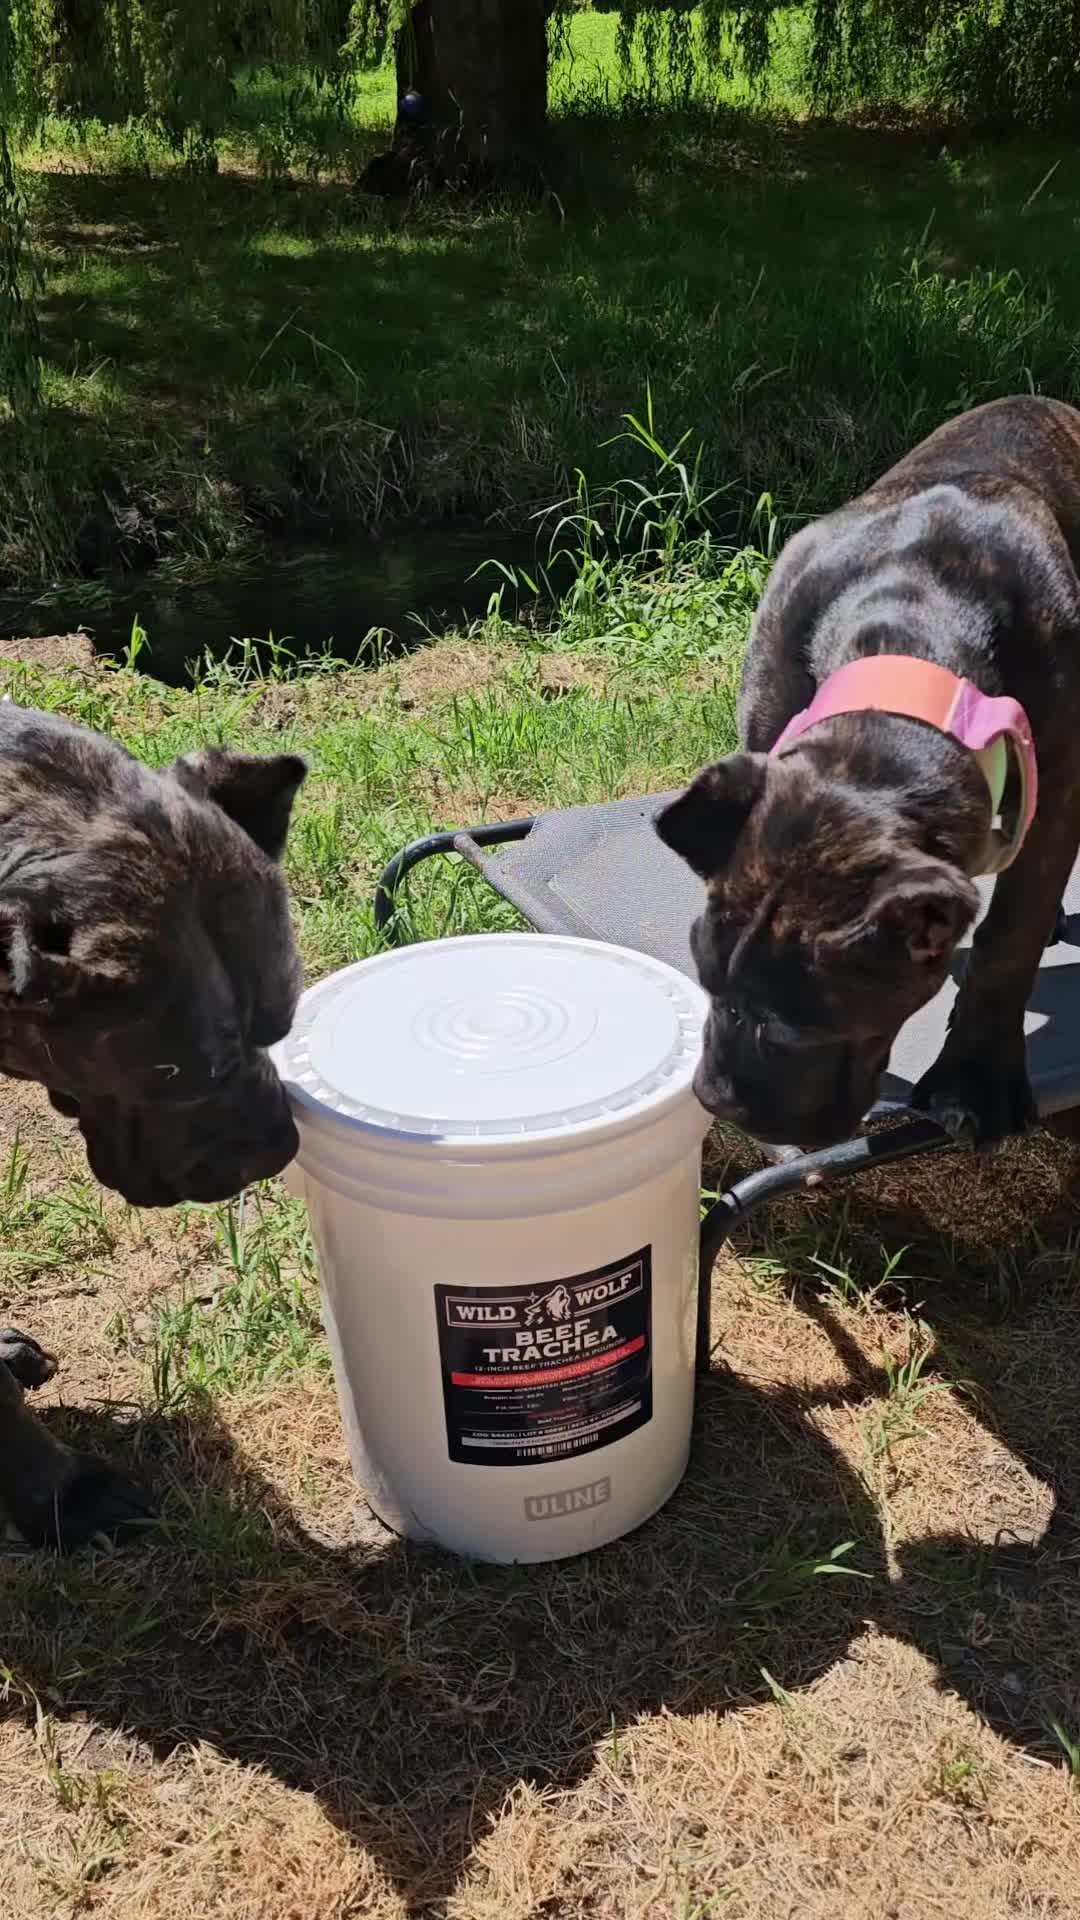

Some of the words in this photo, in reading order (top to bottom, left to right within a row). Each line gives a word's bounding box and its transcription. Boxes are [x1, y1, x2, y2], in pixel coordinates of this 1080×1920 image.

[456, 1305, 516, 1321] WILD
[574, 1273, 632, 1307] WOLF
[483, 1325, 619, 1363] TRACHEA
[515, 1318, 591, 1347] BEEF
[512, 1362, 537, 1371] BEEF
[529, 1480, 610, 1518] ULINE
